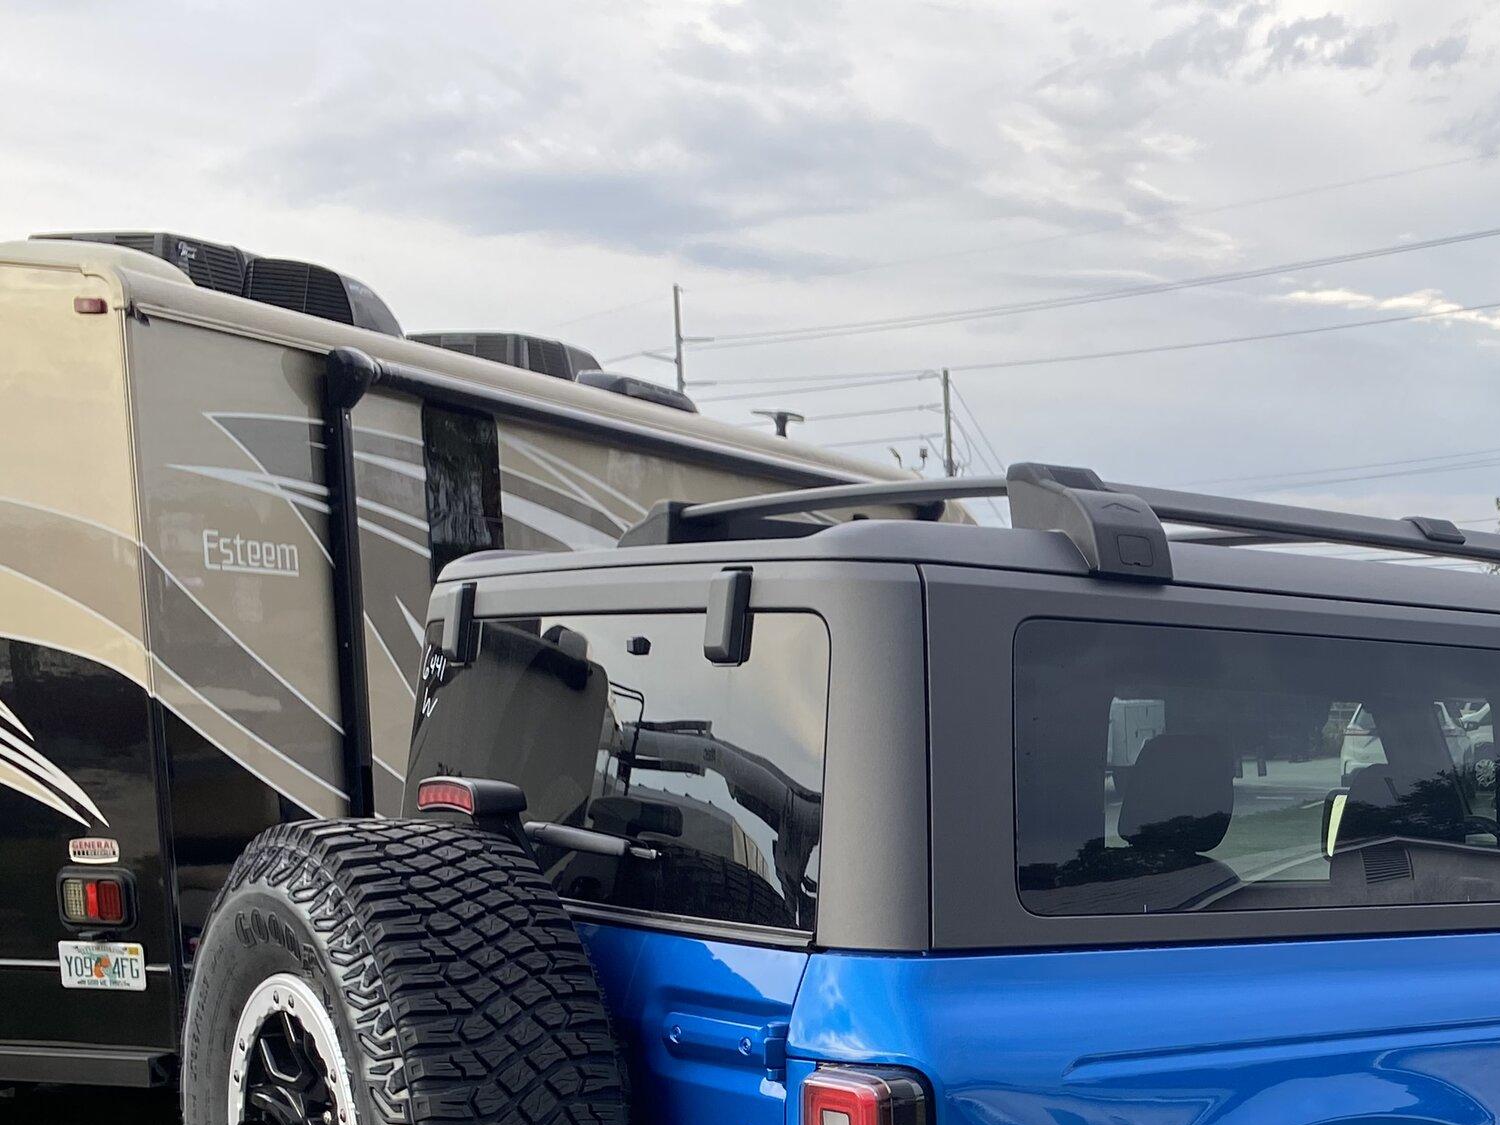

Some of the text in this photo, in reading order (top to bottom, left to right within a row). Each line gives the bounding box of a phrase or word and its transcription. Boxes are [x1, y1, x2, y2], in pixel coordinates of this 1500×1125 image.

[203, 529, 299, 576] Esteem
[423, 644, 447, 682] 6441
[72, 841, 114, 849] GENERAL
[112, 957, 140, 979] 4FG
